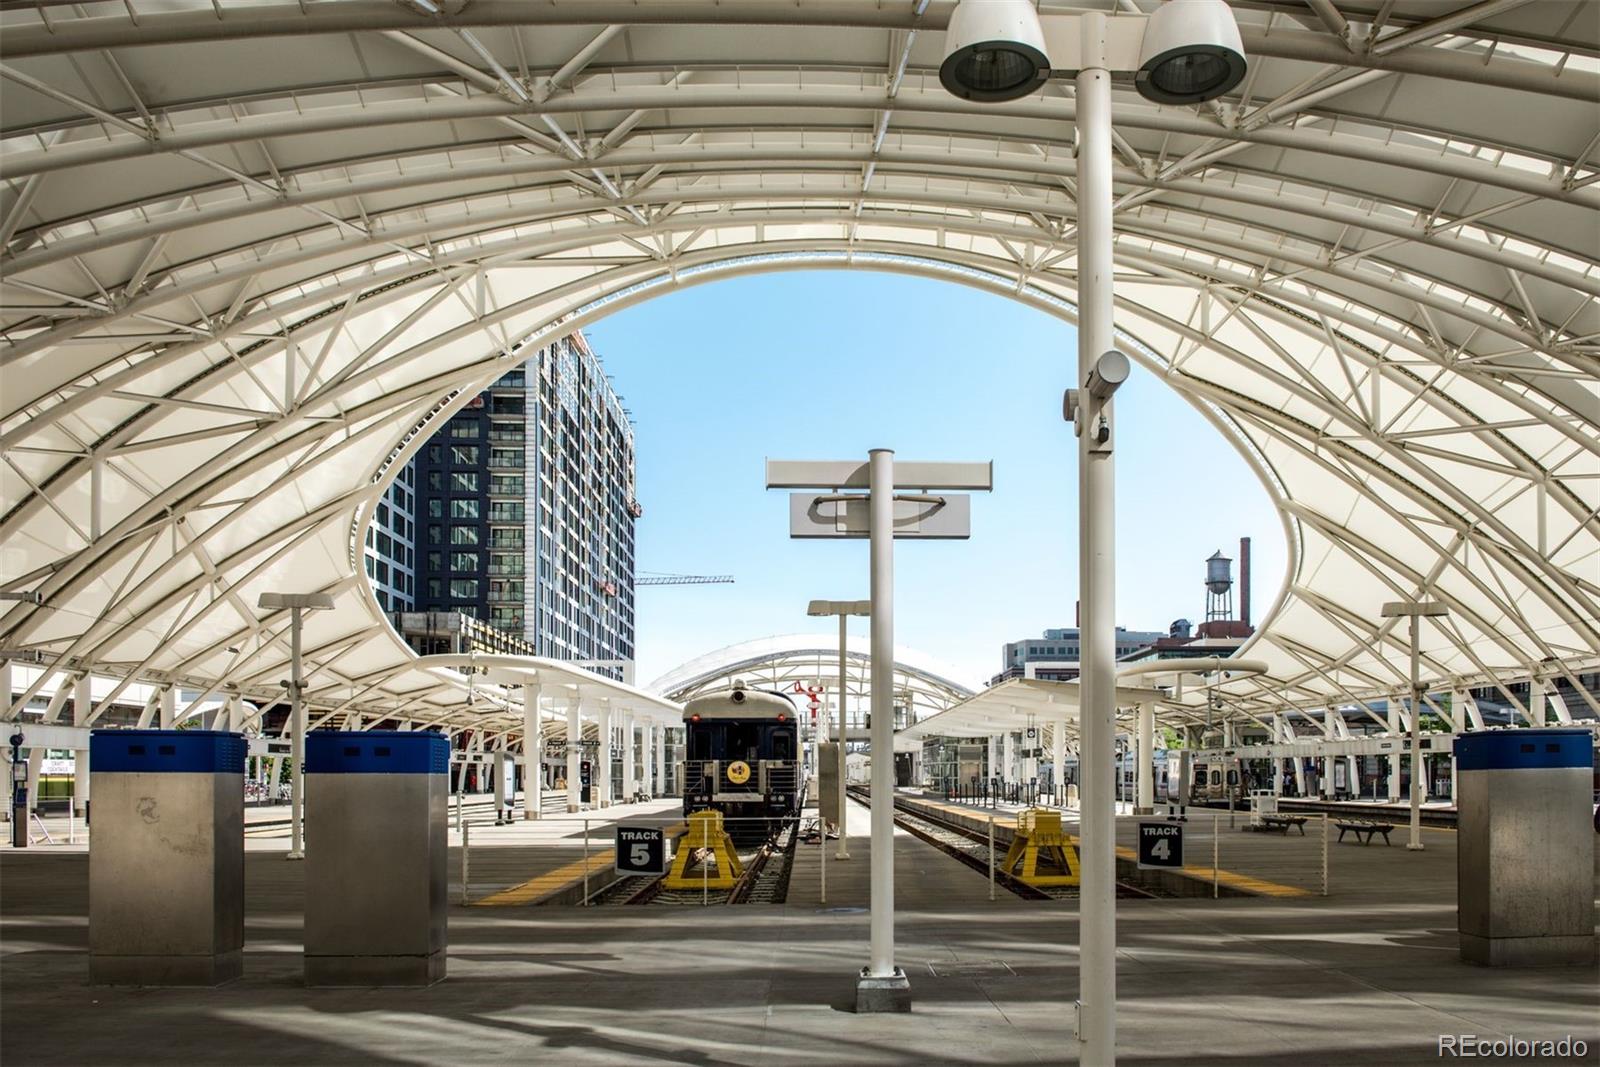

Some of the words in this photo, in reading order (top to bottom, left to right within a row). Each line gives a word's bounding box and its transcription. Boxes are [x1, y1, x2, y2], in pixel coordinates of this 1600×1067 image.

[620, 831, 659, 840] TRACK
[1142, 826, 1178, 836] TRACK
[630, 843, 650, 866] 5
[1151, 838, 1171, 860] 4
